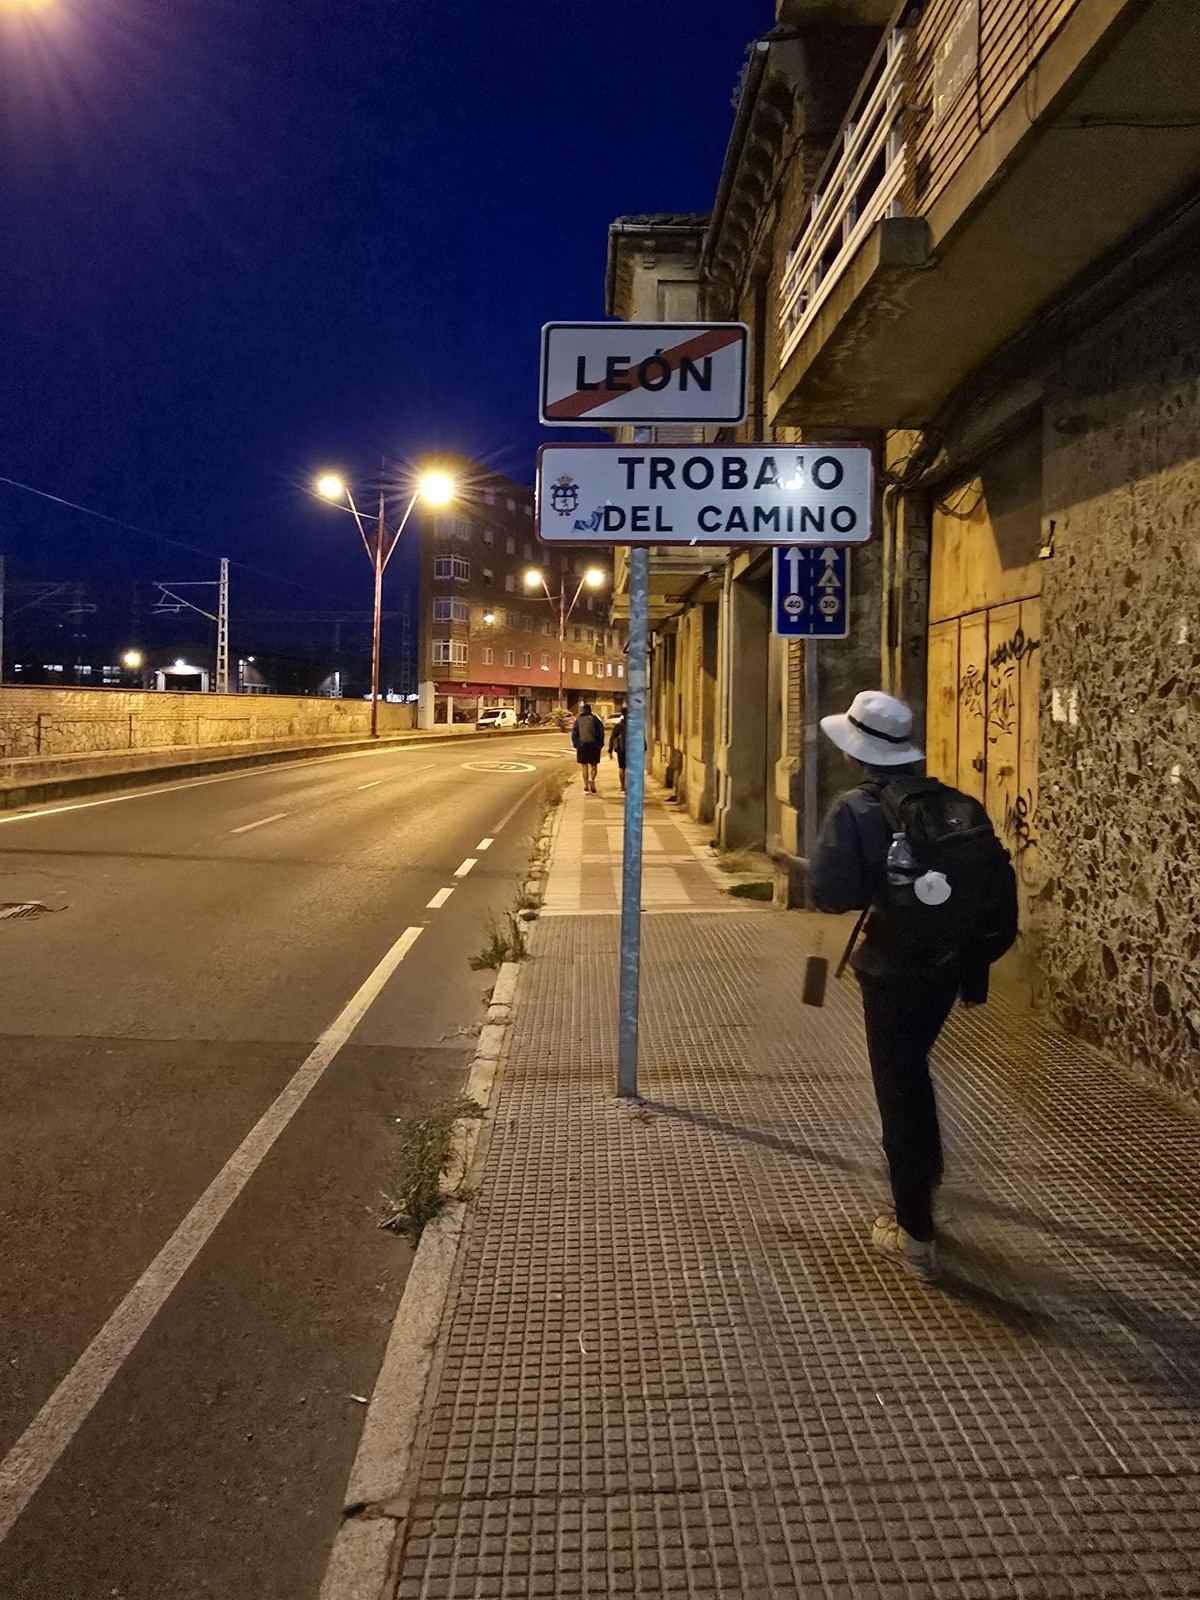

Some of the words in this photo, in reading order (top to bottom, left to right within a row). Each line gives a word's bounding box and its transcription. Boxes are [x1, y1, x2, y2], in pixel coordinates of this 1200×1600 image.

[576, 349, 712, 392] LEÓN
[603, 505, 673, 532] DEL
[697, 505, 857, 533] CAMINO
[787, 600, 801, 609] 40
[822, 600, 836, 609] 30
